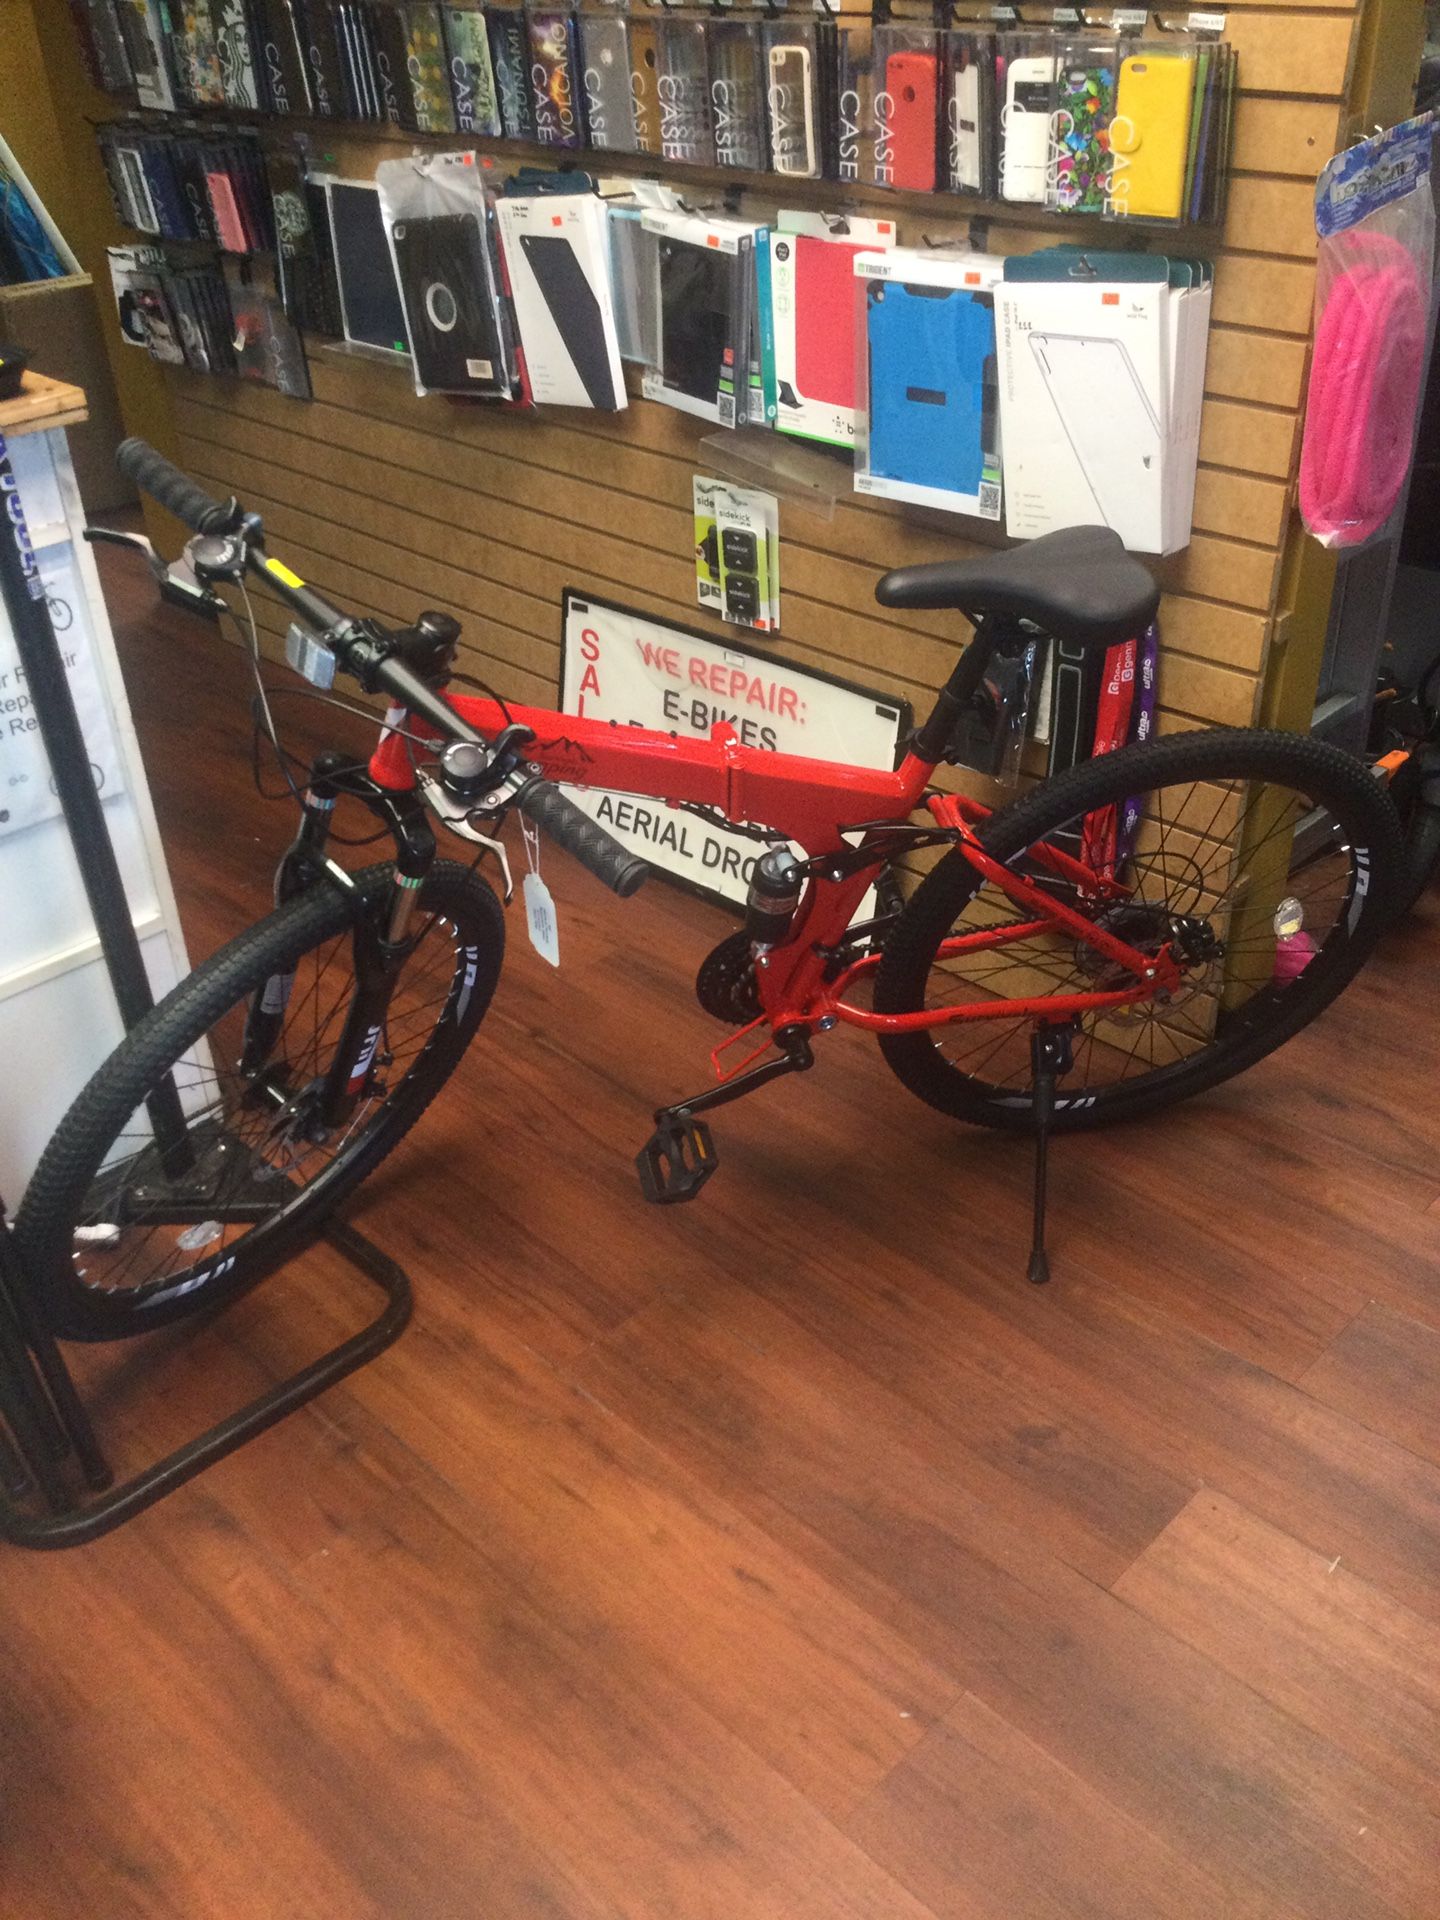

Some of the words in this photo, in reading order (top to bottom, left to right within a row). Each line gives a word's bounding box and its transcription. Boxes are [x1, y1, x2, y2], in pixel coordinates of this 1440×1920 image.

[265, 42, 289, 112] CASE
[310, 45, 331, 115] CASE
[377, 51, 399, 122] CASE
[407, 54, 430, 132] CASE
[451, 56, 474, 131] CASE
[496, 60, 517, 137] CASE
[531, 63, 553, 145] CASE
[551, 23, 576, 140] VOLCANO
[584, 67, 607, 148] CASE
[631, 71, 650, 152] CASE
[657, 75, 681, 158] CASE
[712, 79, 733, 165] CASE
[768, 84, 791, 171] CASE
[839, 90, 861, 179] CASE
[873, 91, 895, 183] CASE
[1045, 108, 1075, 207] CASE
[1103, 115, 1135, 218] CASE
[186, 182, 209, 240] CASE
[272, 194, 296, 258] CASE
[865, 264, 891, 275] TRIDENT
[719, 509, 751, 522] sidekick
[635, 638, 682, 678] WE
[688, 656, 807, 726] REPAIR:
[596, 795, 694, 859] AERIAL
